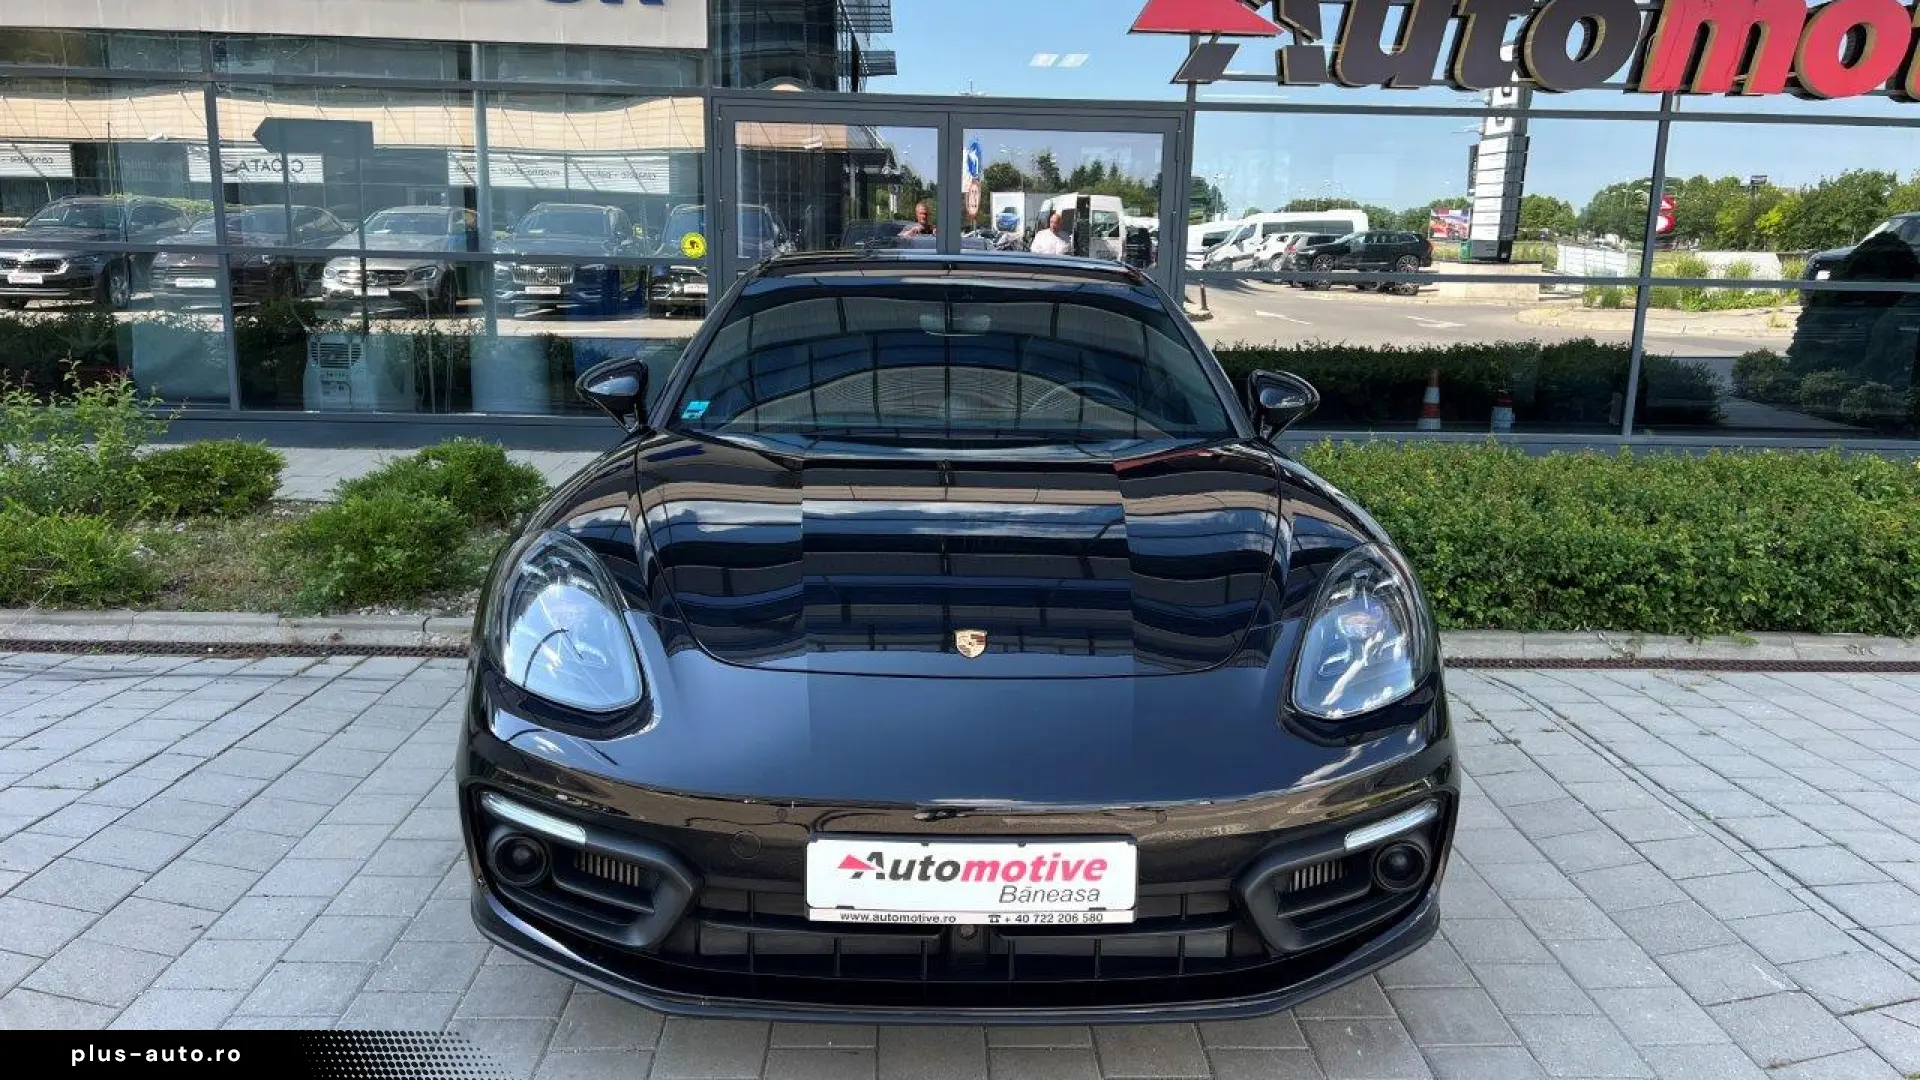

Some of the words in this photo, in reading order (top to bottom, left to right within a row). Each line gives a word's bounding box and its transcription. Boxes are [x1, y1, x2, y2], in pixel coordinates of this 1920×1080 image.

[1130, 0, 1920, 101] Automo
[837, 851, 1108, 882] Automotive
[840, 911, 957, 924] www.automotive.ro
[1015, 912, 1030, 923] 40
[1034, 912, 1054, 923] 722
[1058, 912, 1079, 923] 206
[1082, 911, 1104, 923] 580
